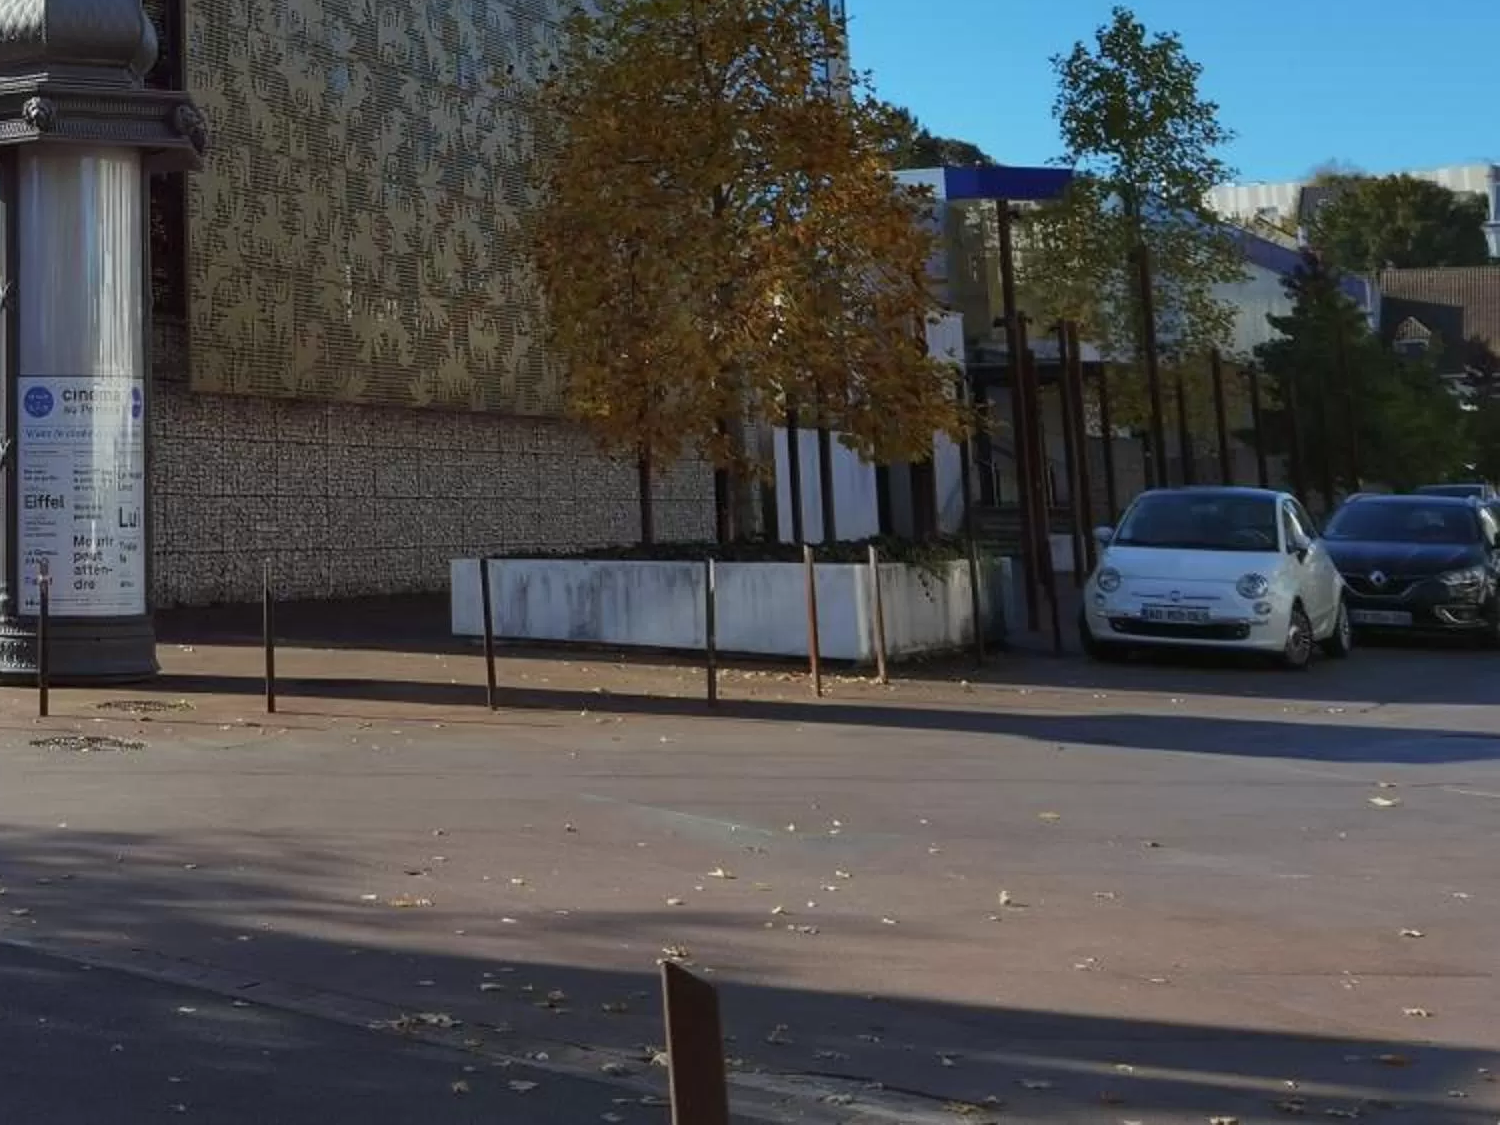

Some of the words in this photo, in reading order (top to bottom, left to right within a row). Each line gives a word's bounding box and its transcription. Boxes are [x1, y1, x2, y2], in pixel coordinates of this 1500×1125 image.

[24, 494, 65, 509] Eiffel
[73, 534, 114, 547] Mourir
[73, 550, 103, 563] peut
[73, 564, 113, 576] atten-
[73, 578, 96, 590] dre
